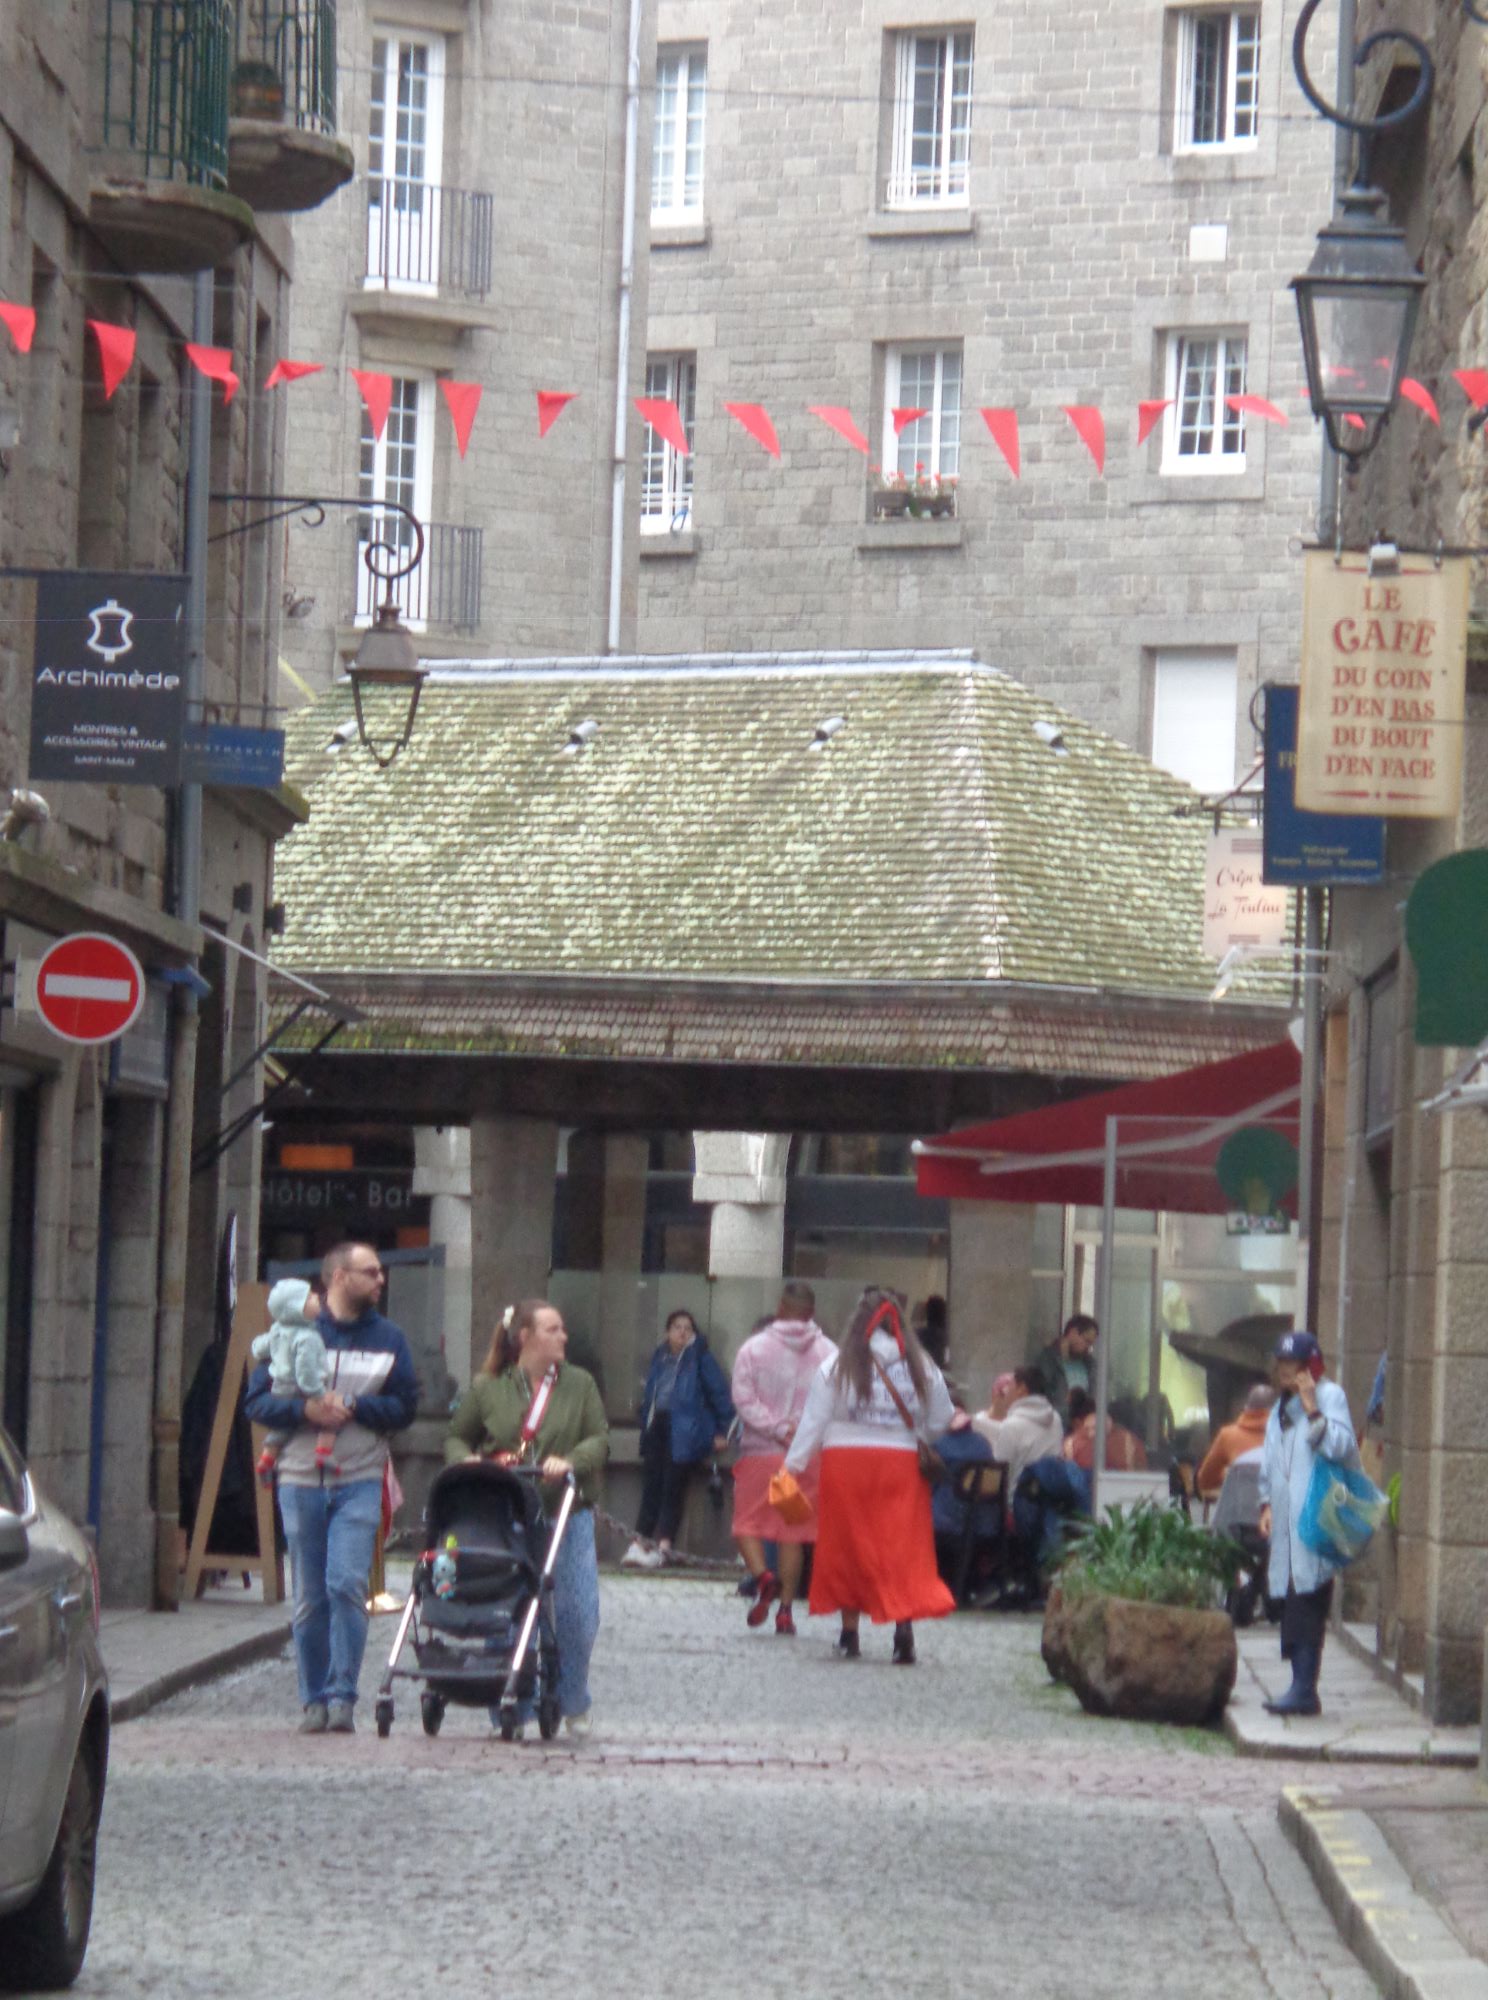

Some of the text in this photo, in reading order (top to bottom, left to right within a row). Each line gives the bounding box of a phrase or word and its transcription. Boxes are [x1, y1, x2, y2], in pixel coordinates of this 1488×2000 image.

[1363, 586, 1402, 611] LE
[37, 666, 180, 690] Archimède
[1332, 665, 1433, 690] DU COIN
[1330, 694, 1385, 719] D'EN
[73, 723, 128, 736] MONTRES
[1332, 725, 1435, 751] DU BOUT
[43, 735, 119, 749] ACCESSOIRES
[121, 738, 167, 751] VINTAGE
[1325, 753, 1437, 779] D'EN FACE
